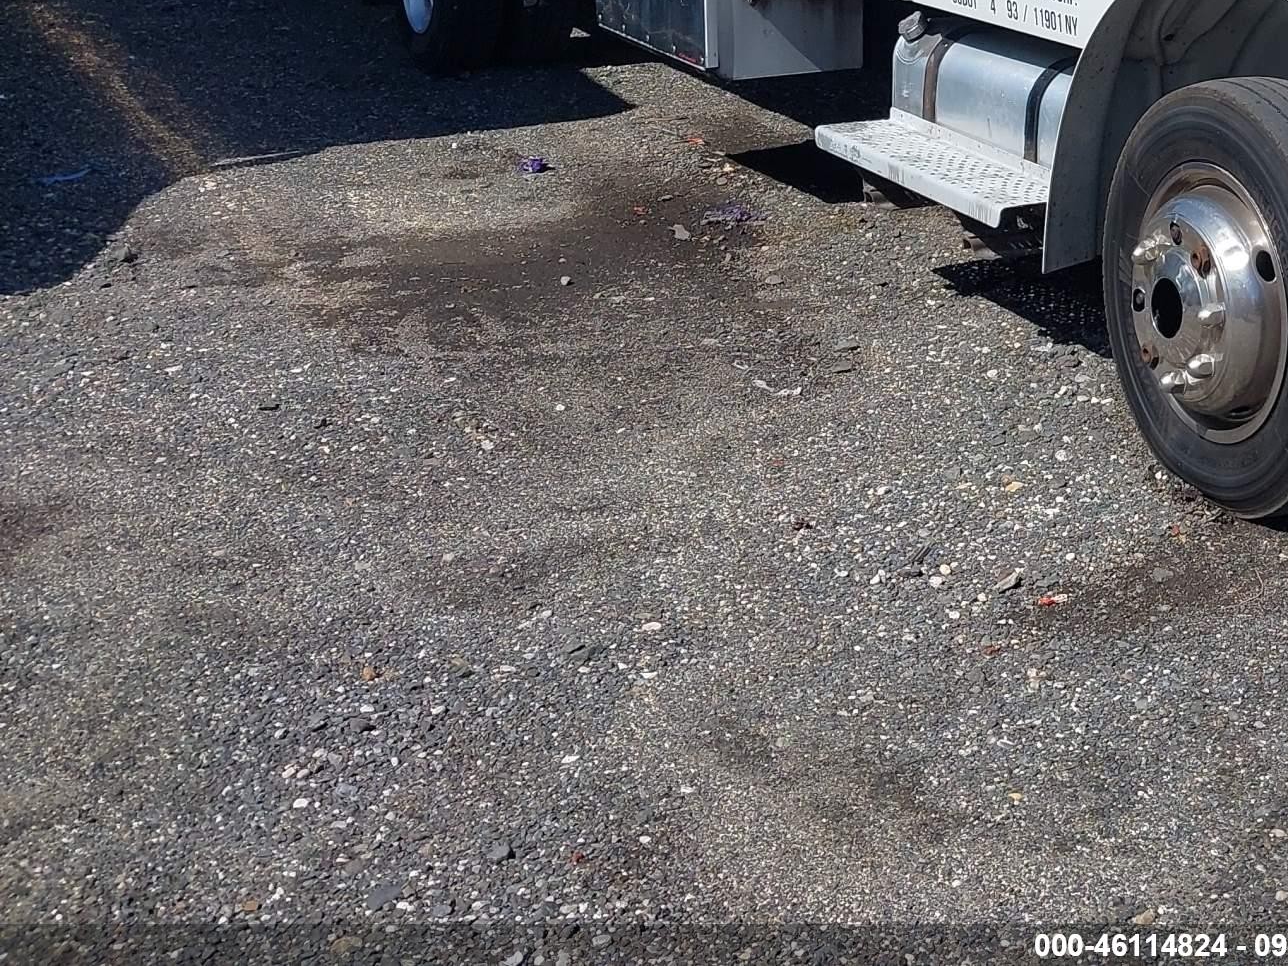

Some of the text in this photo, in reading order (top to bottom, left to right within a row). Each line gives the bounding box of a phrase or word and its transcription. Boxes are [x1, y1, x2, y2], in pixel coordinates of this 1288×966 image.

[1006, 0, 1019, 21] 93
[1034, 7, 1063, 33] 11901
[1065, 15, 1078, 36] NY
